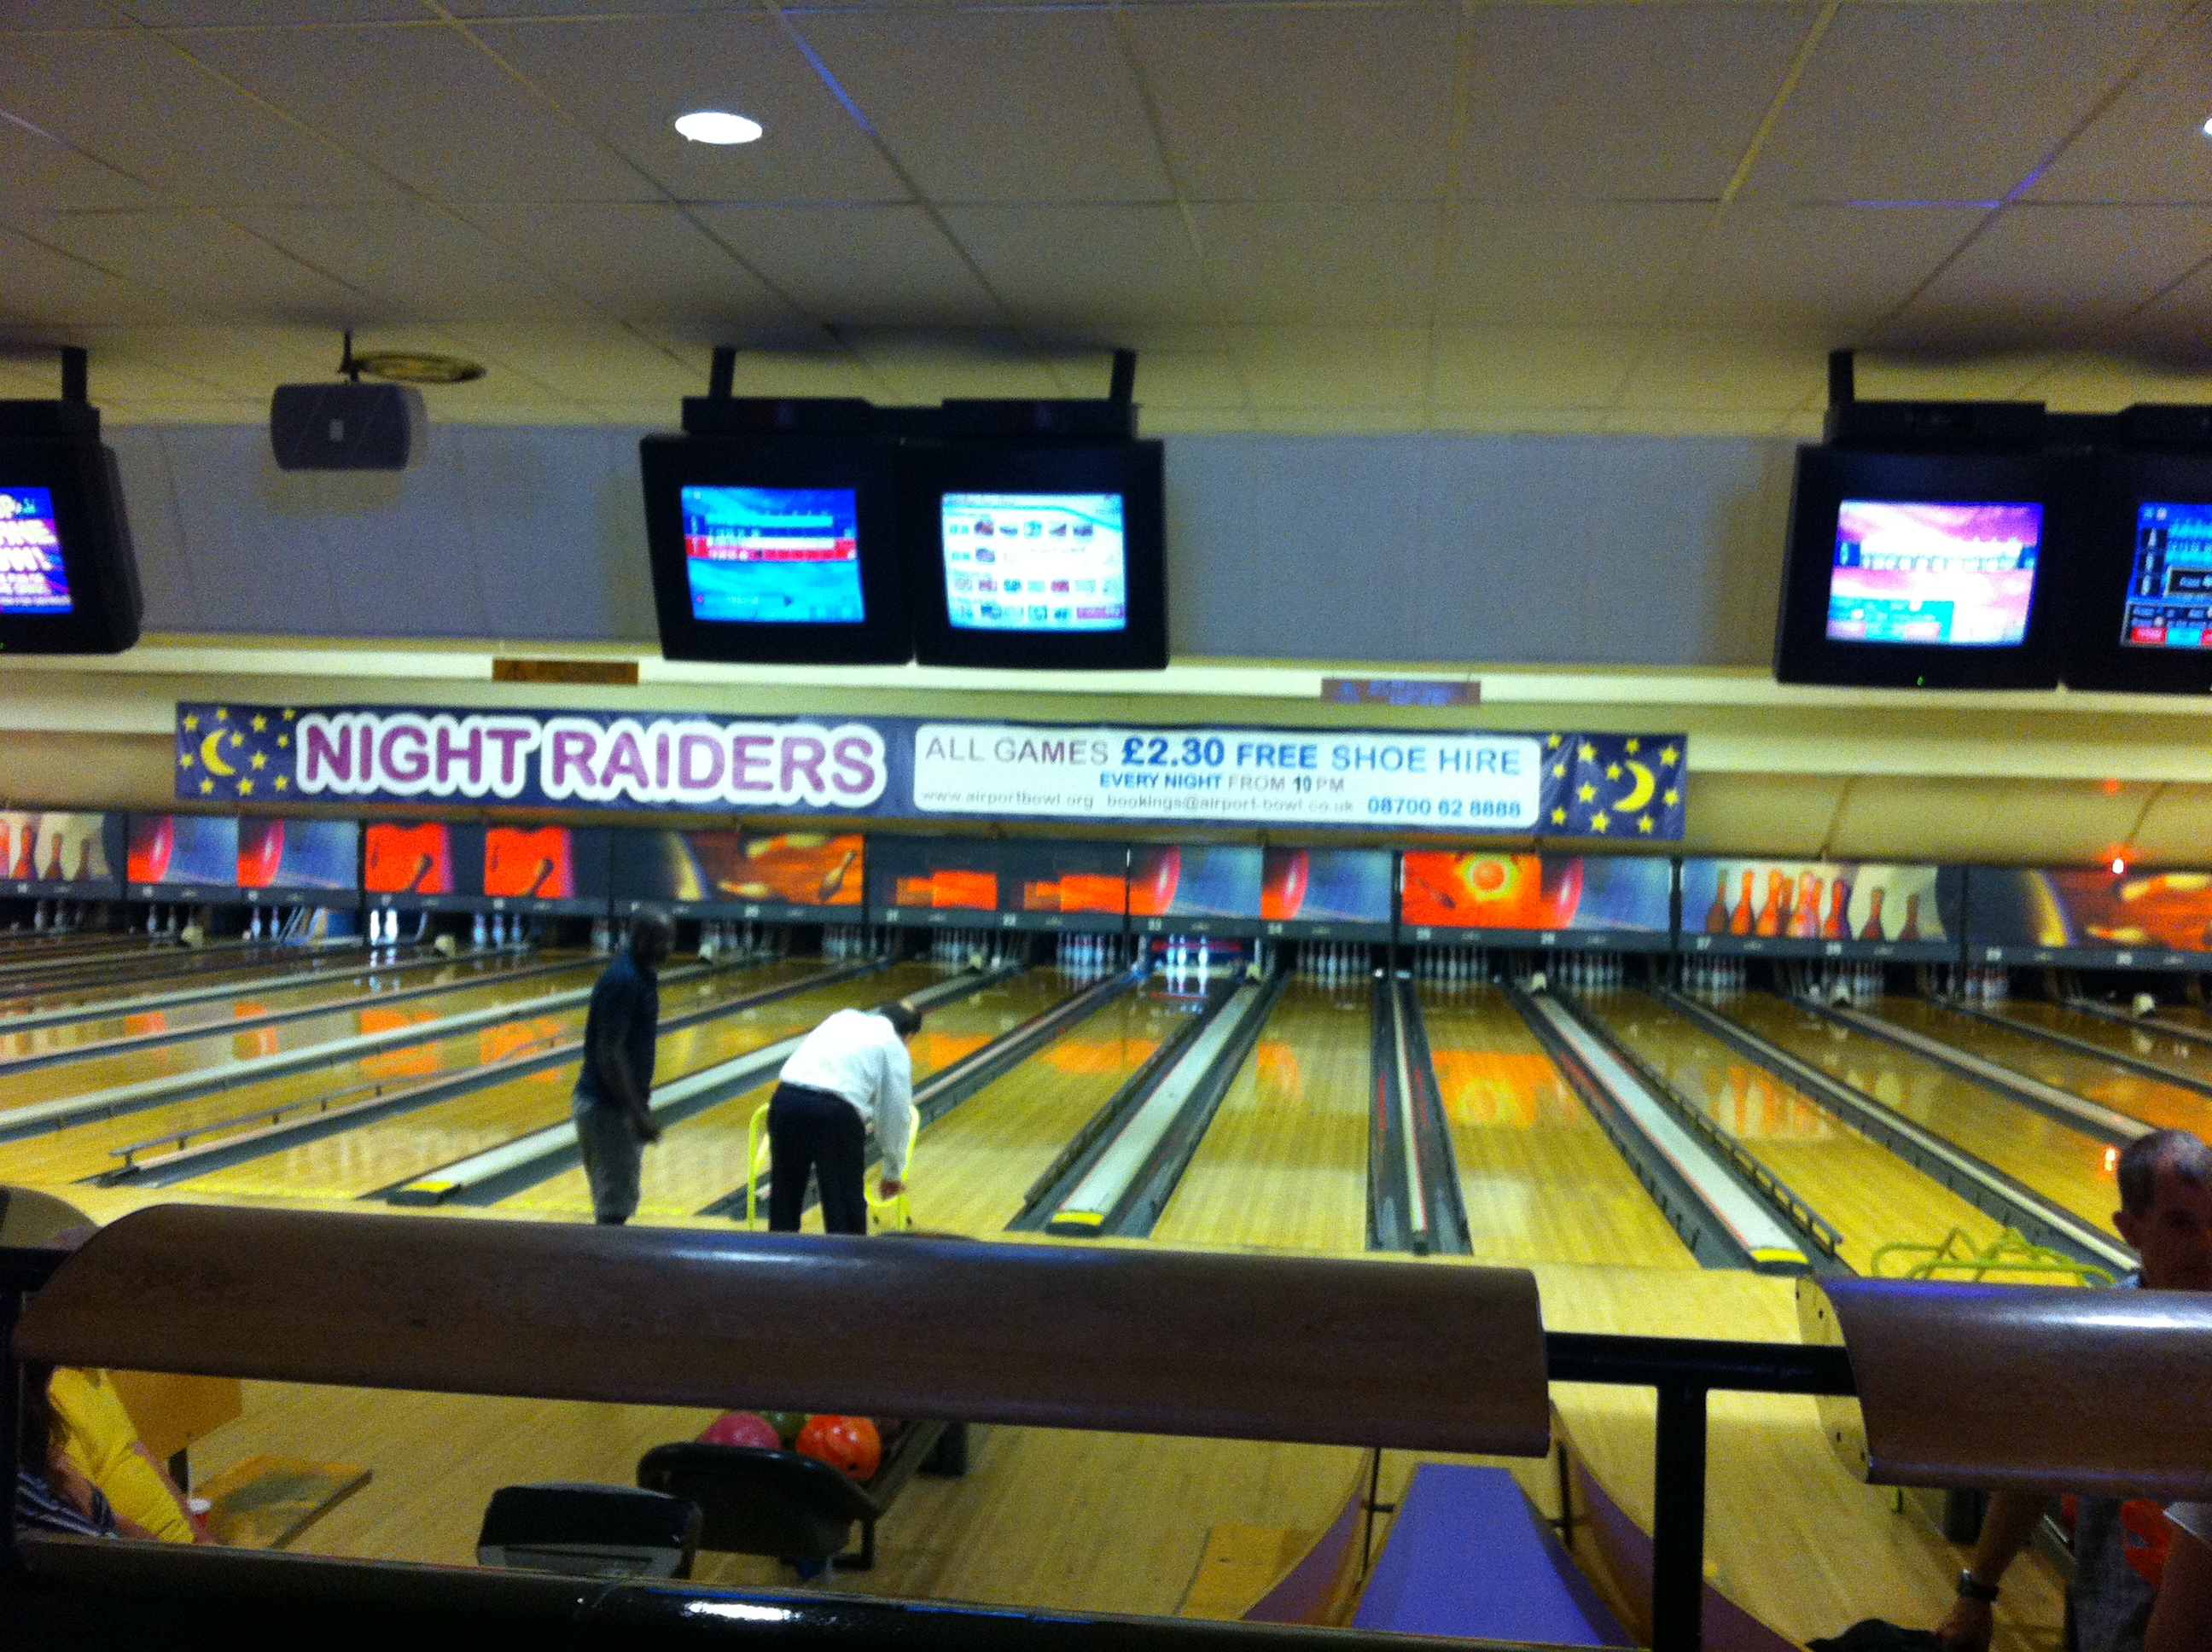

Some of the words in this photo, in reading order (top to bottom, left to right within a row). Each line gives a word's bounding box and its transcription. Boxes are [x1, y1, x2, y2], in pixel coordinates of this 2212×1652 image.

[302, 721, 534, 787] NIGHT
[549, 725, 880, 799] RAIDERS
[925, 736, 985, 762] ALL
[993, 736, 1109, 766] GAMES
[1121, 736, 1225, 767] £2.30
[1237, 741, 1318, 770] FREE
[1331, 744, 1428, 773] SHOE
[1439, 747, 1522, 776] HIRE
[1099, 771, 1160, 788] EVERY
[1164, 772, 1224, 789] NIGHT
[1228, 774, 1286, 792] FROM
